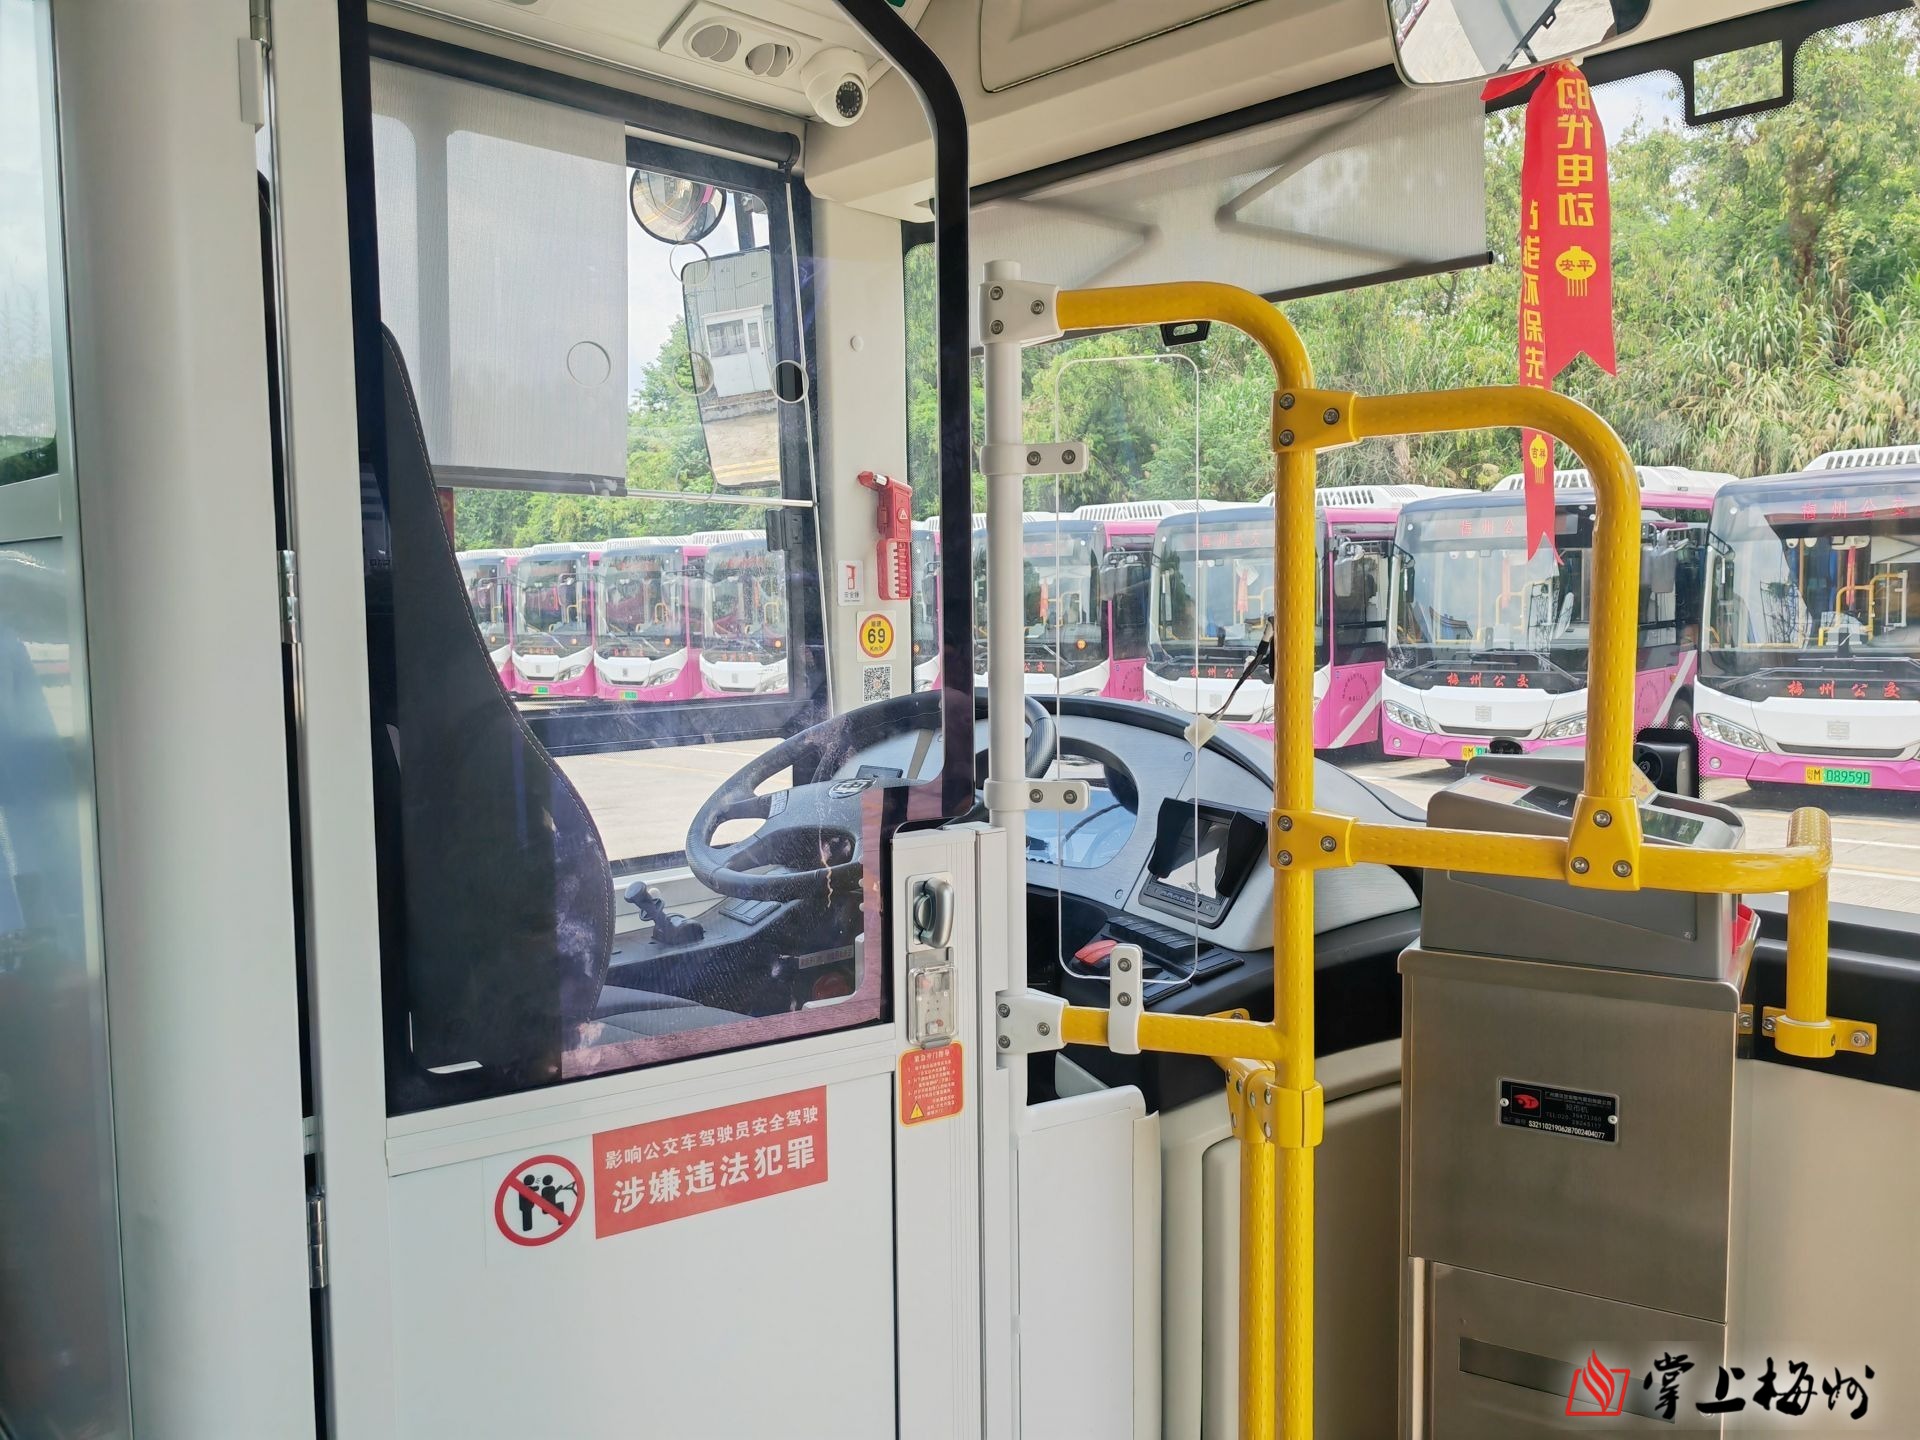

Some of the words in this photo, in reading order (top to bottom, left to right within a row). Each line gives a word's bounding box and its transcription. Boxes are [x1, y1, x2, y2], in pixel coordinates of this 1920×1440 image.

[867, 628, 886, 644] 69
[1446, 671, 1530, 689] 梅州公交
[1786, 679, 1901, 699] 梅州公交
[605, 1105, 819, 1170] 影响公交车驾驶员安全驾驶
[612, 1135, 816, 1214] 涉嫌违法犯罪
